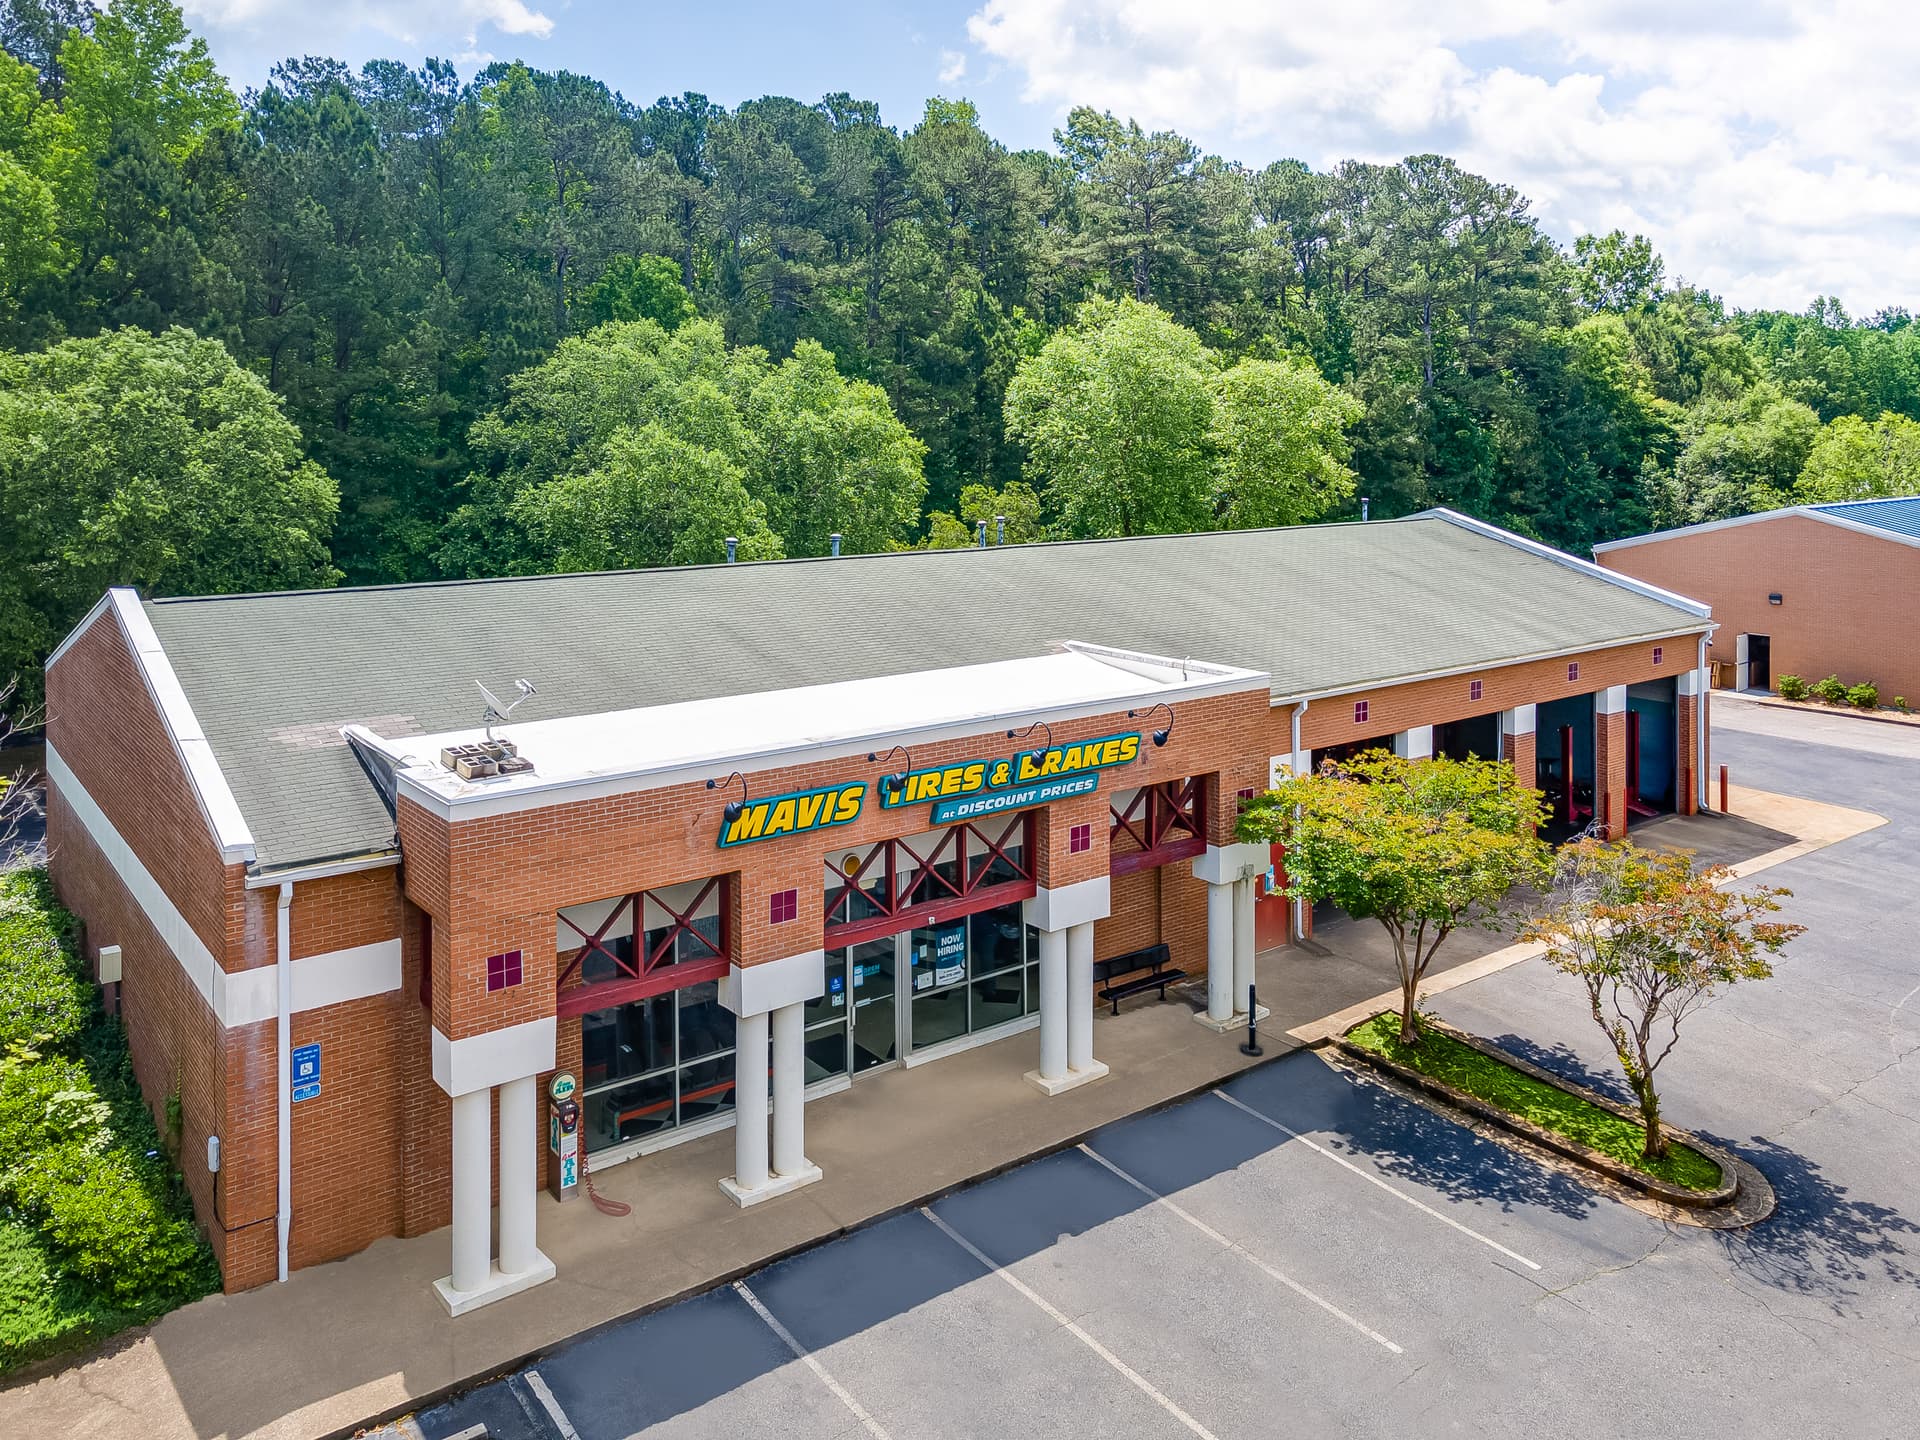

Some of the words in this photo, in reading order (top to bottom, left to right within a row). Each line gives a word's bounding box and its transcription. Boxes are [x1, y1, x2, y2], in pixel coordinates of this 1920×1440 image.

[726, 786, 864, 843] MAVIS
[991, 762, 1010, 784] &
[1019, 737, 1139, 780] BRAKES
[957, 790, 1037, 816] DISCOUNT
[1040, 779, 1093, 799] PRICES
[937, 942, 965, 957] HIRING
[941, 933, 961, 946] NOW
[563, 1157, 575, 1187] AIR
